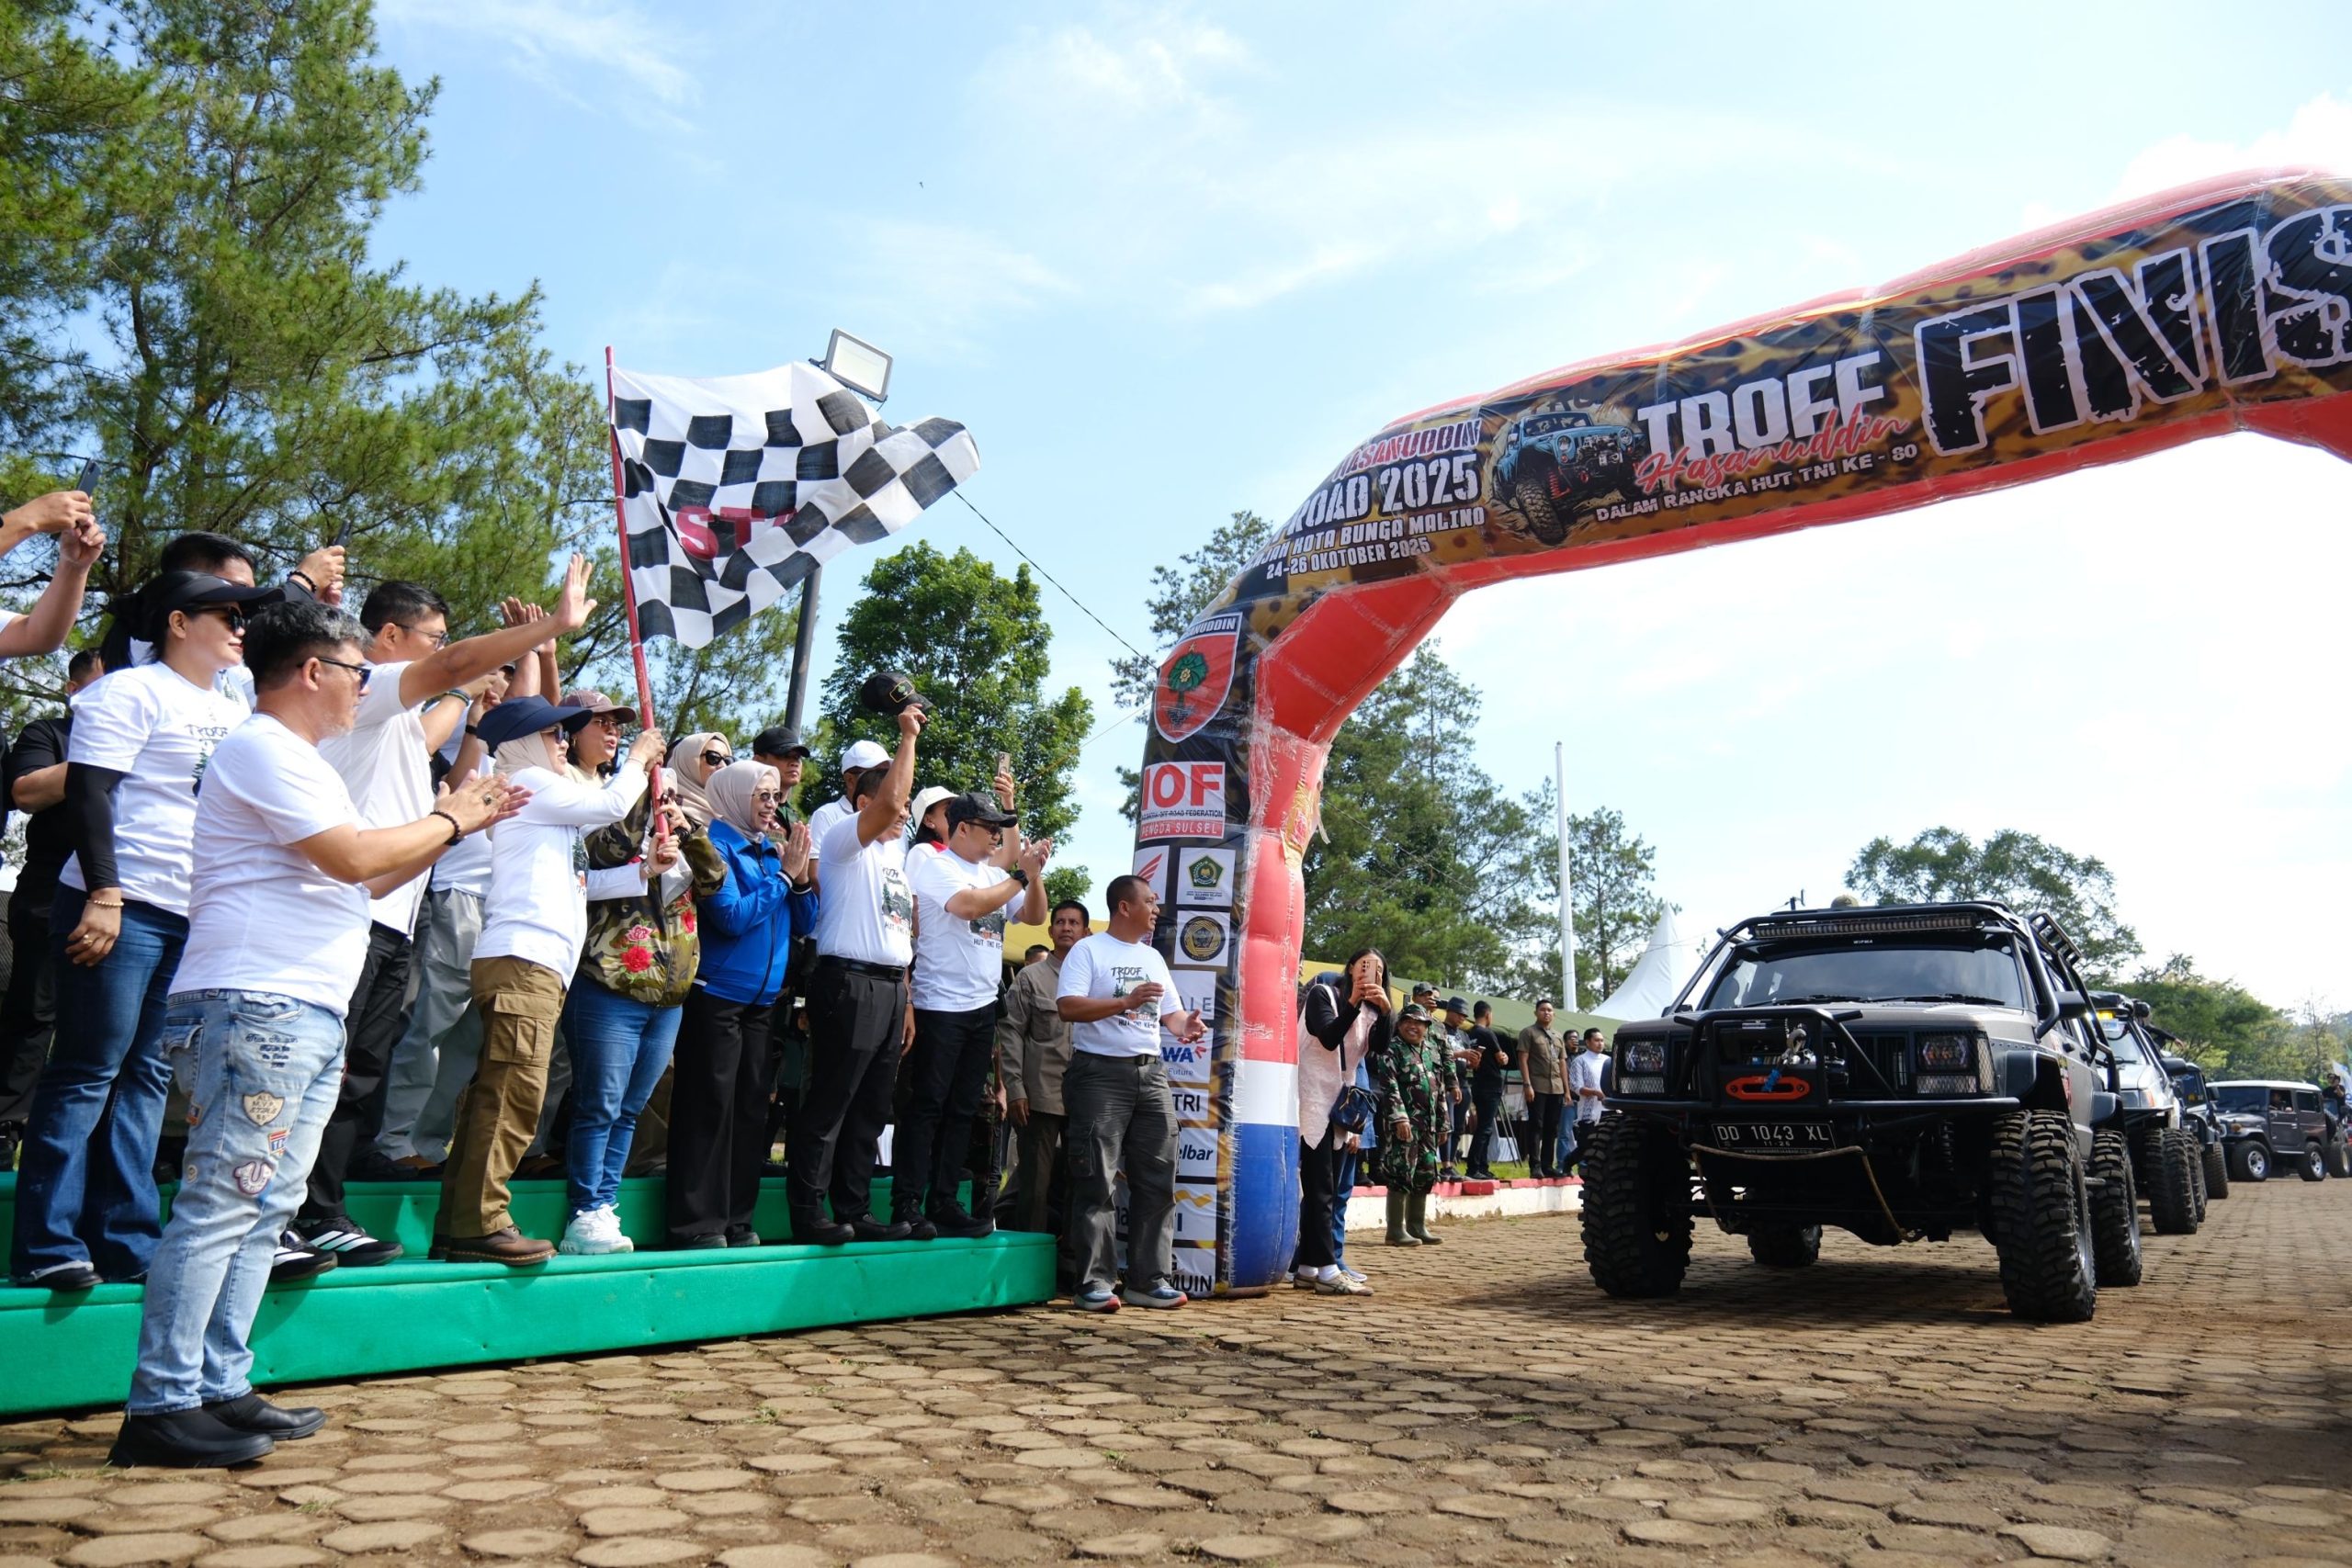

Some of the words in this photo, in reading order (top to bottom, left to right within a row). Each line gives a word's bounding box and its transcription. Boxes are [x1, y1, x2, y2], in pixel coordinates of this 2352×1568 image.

[1637, 350, 1884, 465] TROFF
[1634, 402, 1912, 495] Hasanuddin
[1272, 475, 1369, 544] ROAD
[1379, 453, 1479, 513] 2025
[1597, 497, 1658, 522] DALAM
[1664, 479, 1747, 510] RANGKA
[1752, 470, 1793, 492] HUT
[1798, 462, 1836, 483] TNI
[1843, 453, 1873, 474] KE
[1893, 444, 1917, 462] 80
[1292, 527, 1336, 556] KOTA
[1340, 518, 1405, 546] BUNGA
[1408, 506, 1486, 534] MALINO
[1266, 556, 1308, 580] 24-26
[1310, 545, 1387, 570] OKOTOBER
[1390, 536, 1430, 559] 2025
[1141, 763, 1223, 811] IOF
[1175, 822, 1217, 834] SULSEL
[1185, 808, 1223, 818] FEDERATION
[1110, 966, 1143, 977] TROOF
[1159, 1046, 1193, 1063] WA
[1168, 1067, 1193, 1076] Future
[1171, 1093, 1201, 1112] TRI
[1717, 1125, 1740, 1141] DD
[1750, 1125, 1794, 1141] 1043
[1805, 1125, 1829, 1141] XL
